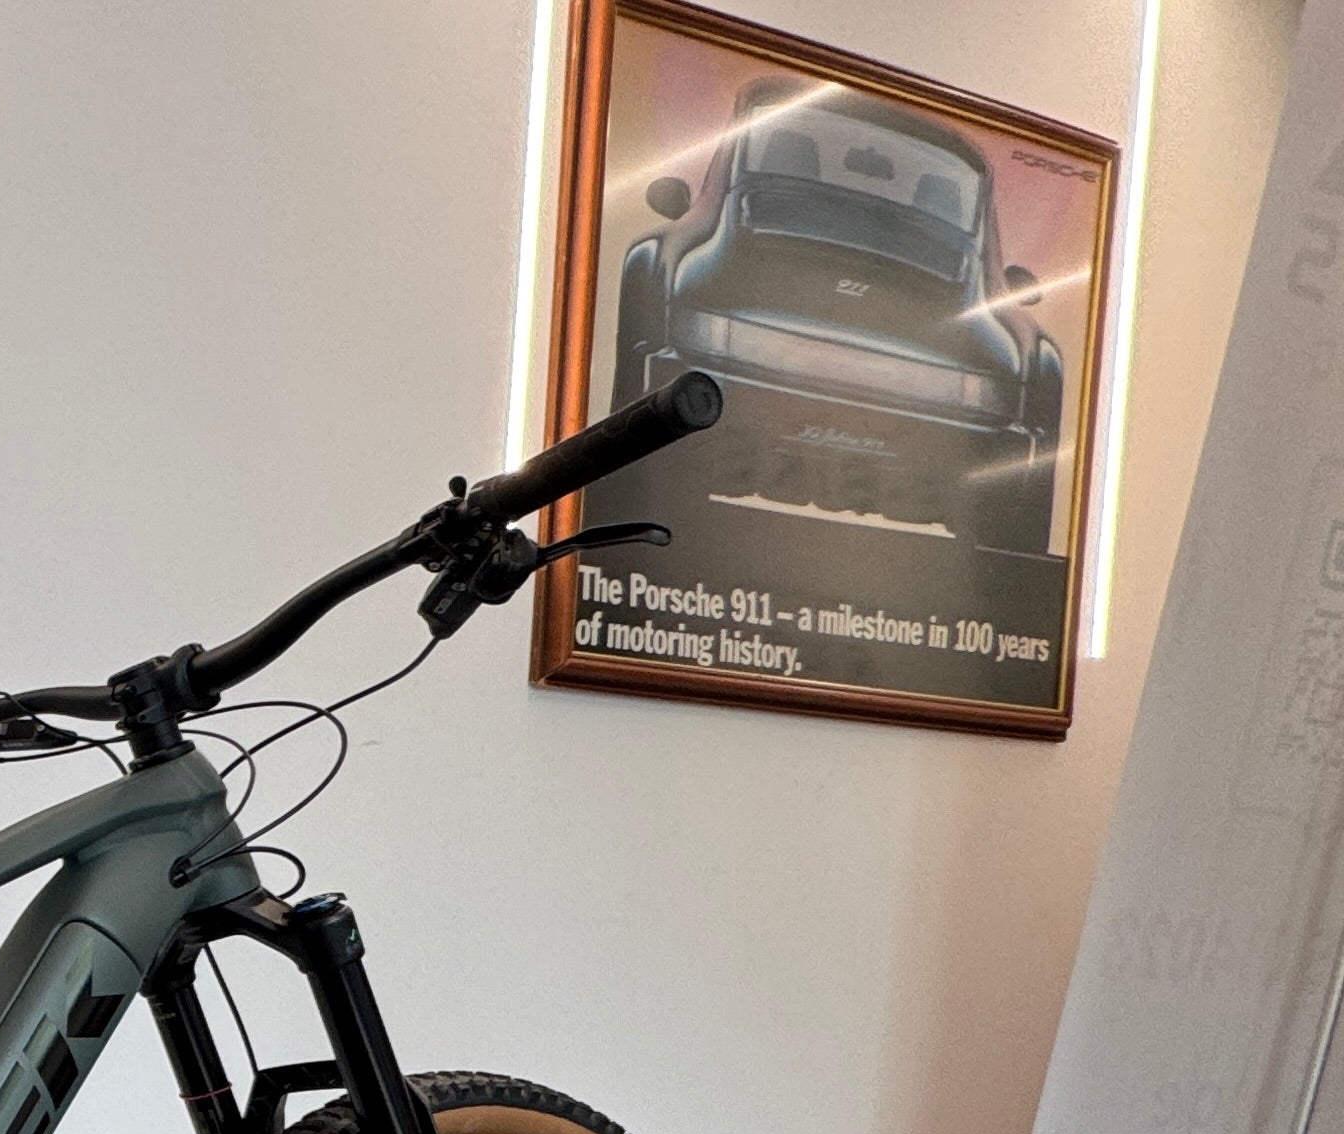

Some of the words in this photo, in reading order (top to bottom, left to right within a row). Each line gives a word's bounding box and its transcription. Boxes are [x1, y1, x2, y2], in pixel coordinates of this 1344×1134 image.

[575, 610, 604, 647] of
[606, 619, 715, 667] motoring
[719, 628, 803, 676] history.
[578, 564, 623, 605] The
[630, 572, 725, 620] Porsche
[731, 588, 773, 627] 911
[798, 605, 812, 632] a
[818, 603, 924, 646] milestone
[928, 615, 949, 650] in
[952, 619, 994, 655] 100
[995, 632, 1050, 663] years
